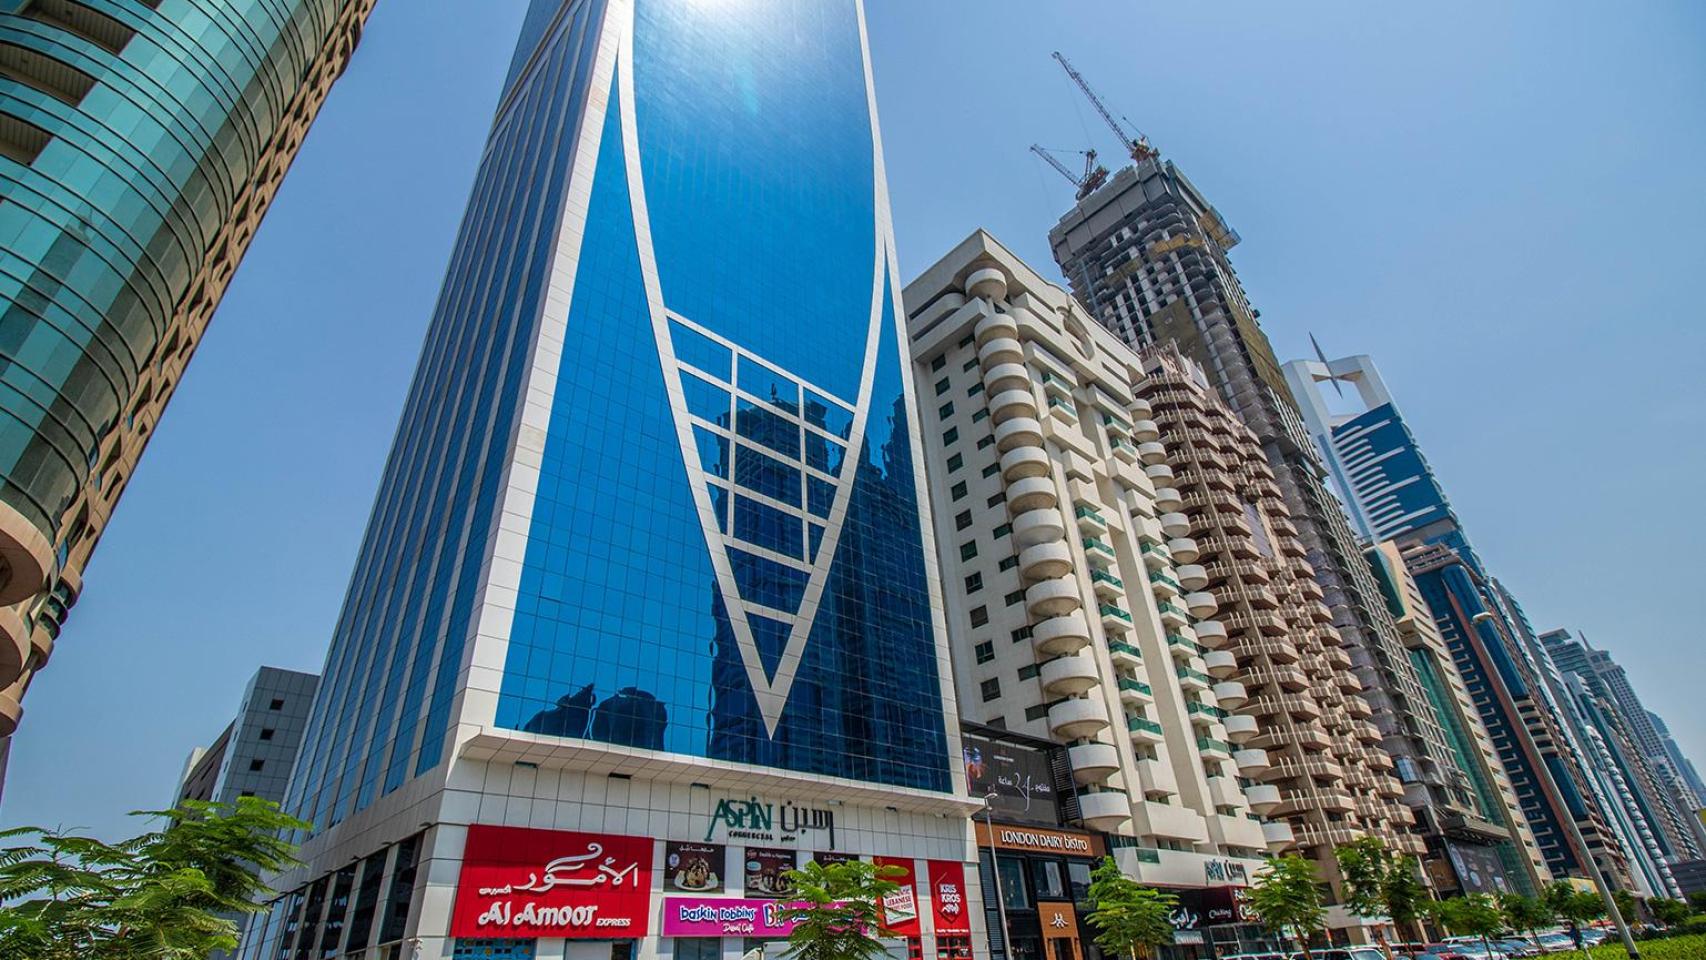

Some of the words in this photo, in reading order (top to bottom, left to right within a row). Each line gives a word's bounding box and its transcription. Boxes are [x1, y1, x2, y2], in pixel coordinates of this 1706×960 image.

[1001, 830, 1039, 848] LONDON
[1039, 834, 1063, 849] DAIRY
[1062, 833, 1088, 851] bistro
[940, 884, 957, 894] KRIS
[942, 894, 961, 904] KROS
[478, 901, 512, 926] Al
[513, 902, 598, 926] Amoor
[680, 904, 719, 923] baskin
[720, 905, 758, 922] robbins
[596, 917, 632, 927] EXPRESS
